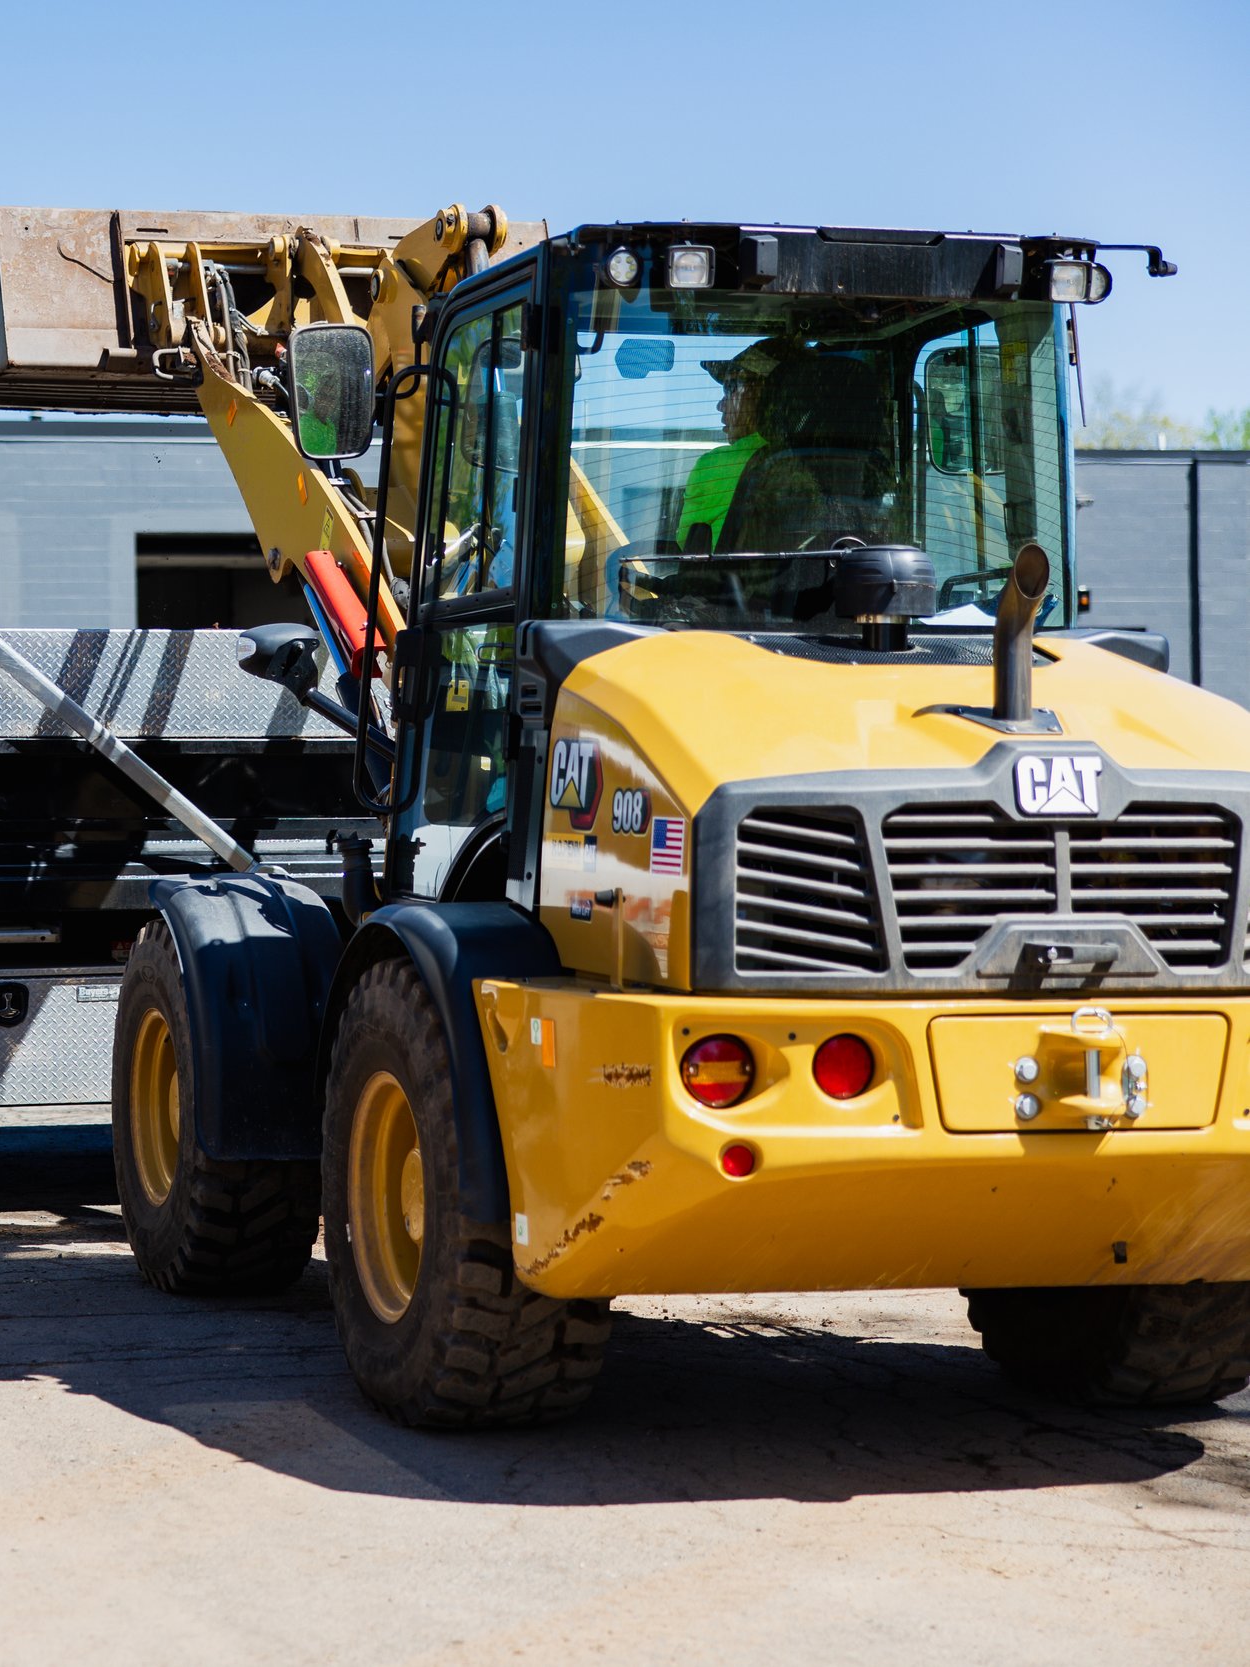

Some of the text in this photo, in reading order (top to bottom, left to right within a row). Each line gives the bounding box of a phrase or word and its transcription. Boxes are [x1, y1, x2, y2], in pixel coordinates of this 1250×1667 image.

[551, 740, 593, 808] CAT
[1015, 755, 1103, 815] CAT
[613, 788, 643, 832] 908
